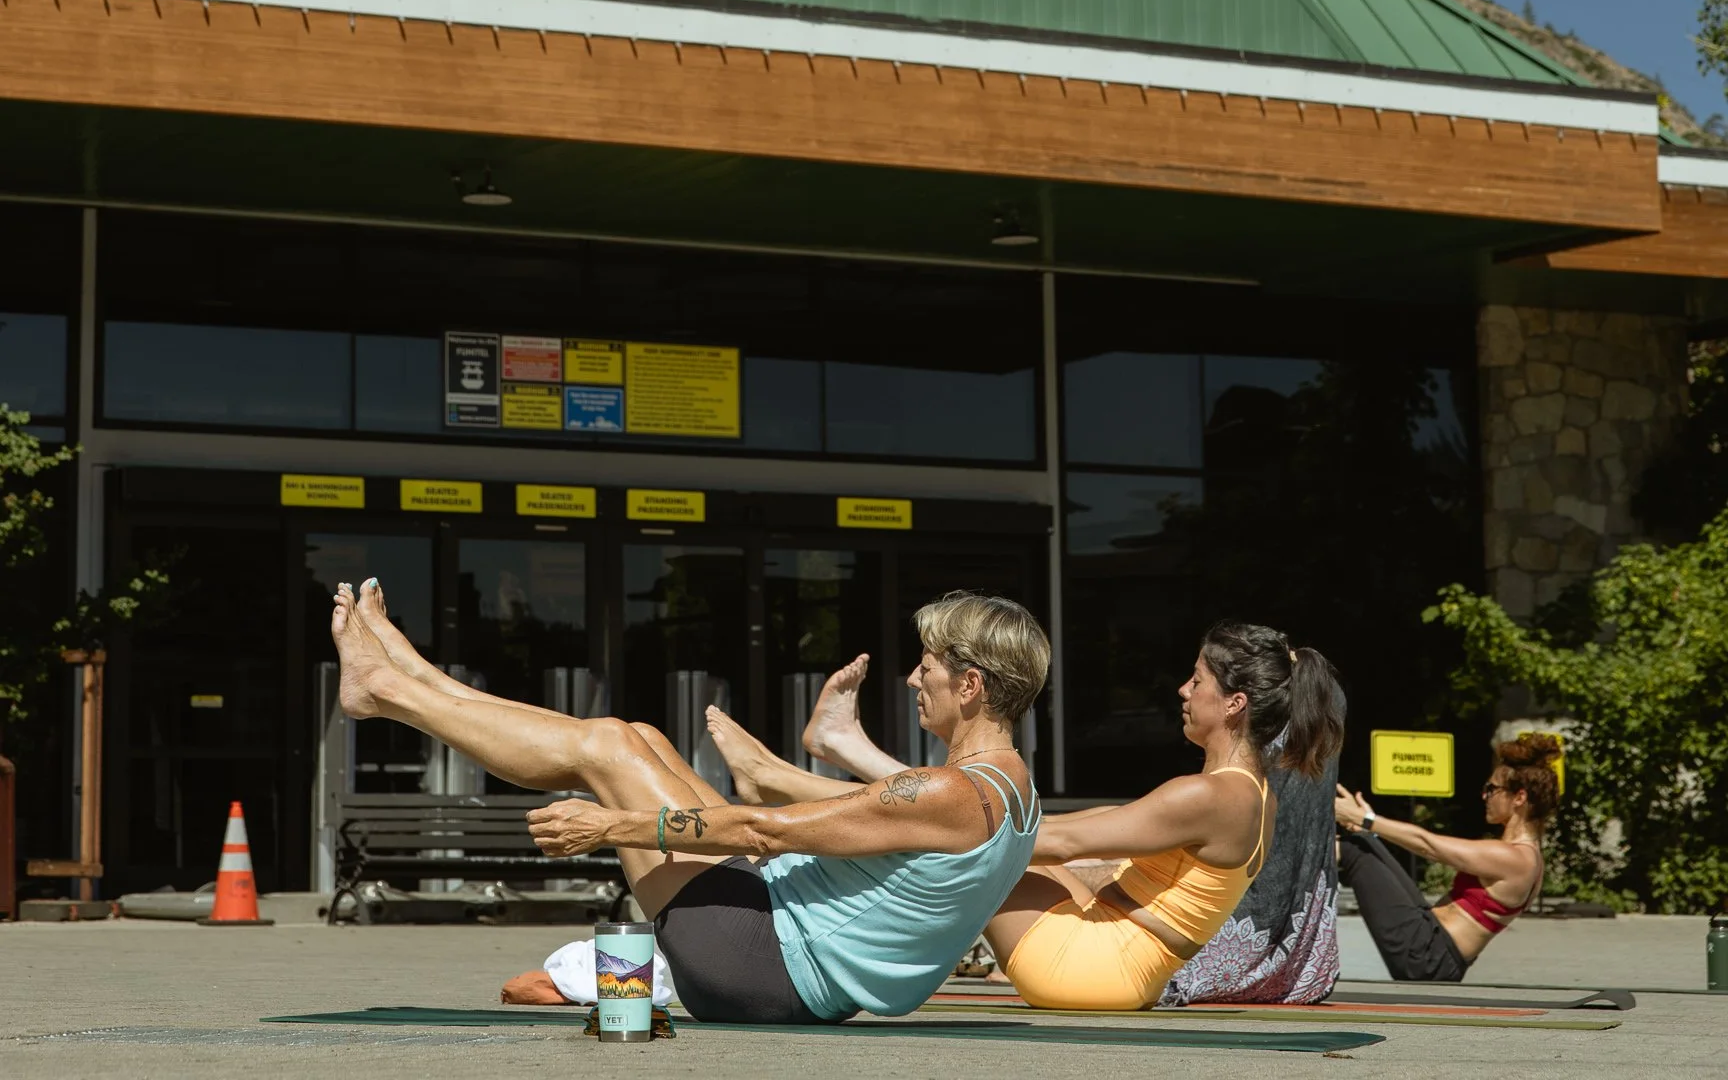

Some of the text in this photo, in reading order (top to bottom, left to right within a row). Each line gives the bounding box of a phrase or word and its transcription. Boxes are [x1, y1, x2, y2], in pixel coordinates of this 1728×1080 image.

[425, 487, 459, 496] SEATED
[540, 491, 574, 500] SEATED
[411, 496, 472, 507] PASSENGERS
[644, 496, 688, 505] STANDING
[527, 501, 586, 512] PASSENGERS
[637, 506, 695, 516] PASSENGERS
[854, 504, 897, 514] STANDING
[847, 514, 902, 524] PASSENGERS
[1392, 752, 1434, 763] FUNITEL
[1392, 765, 1435, 776] CLOSED
